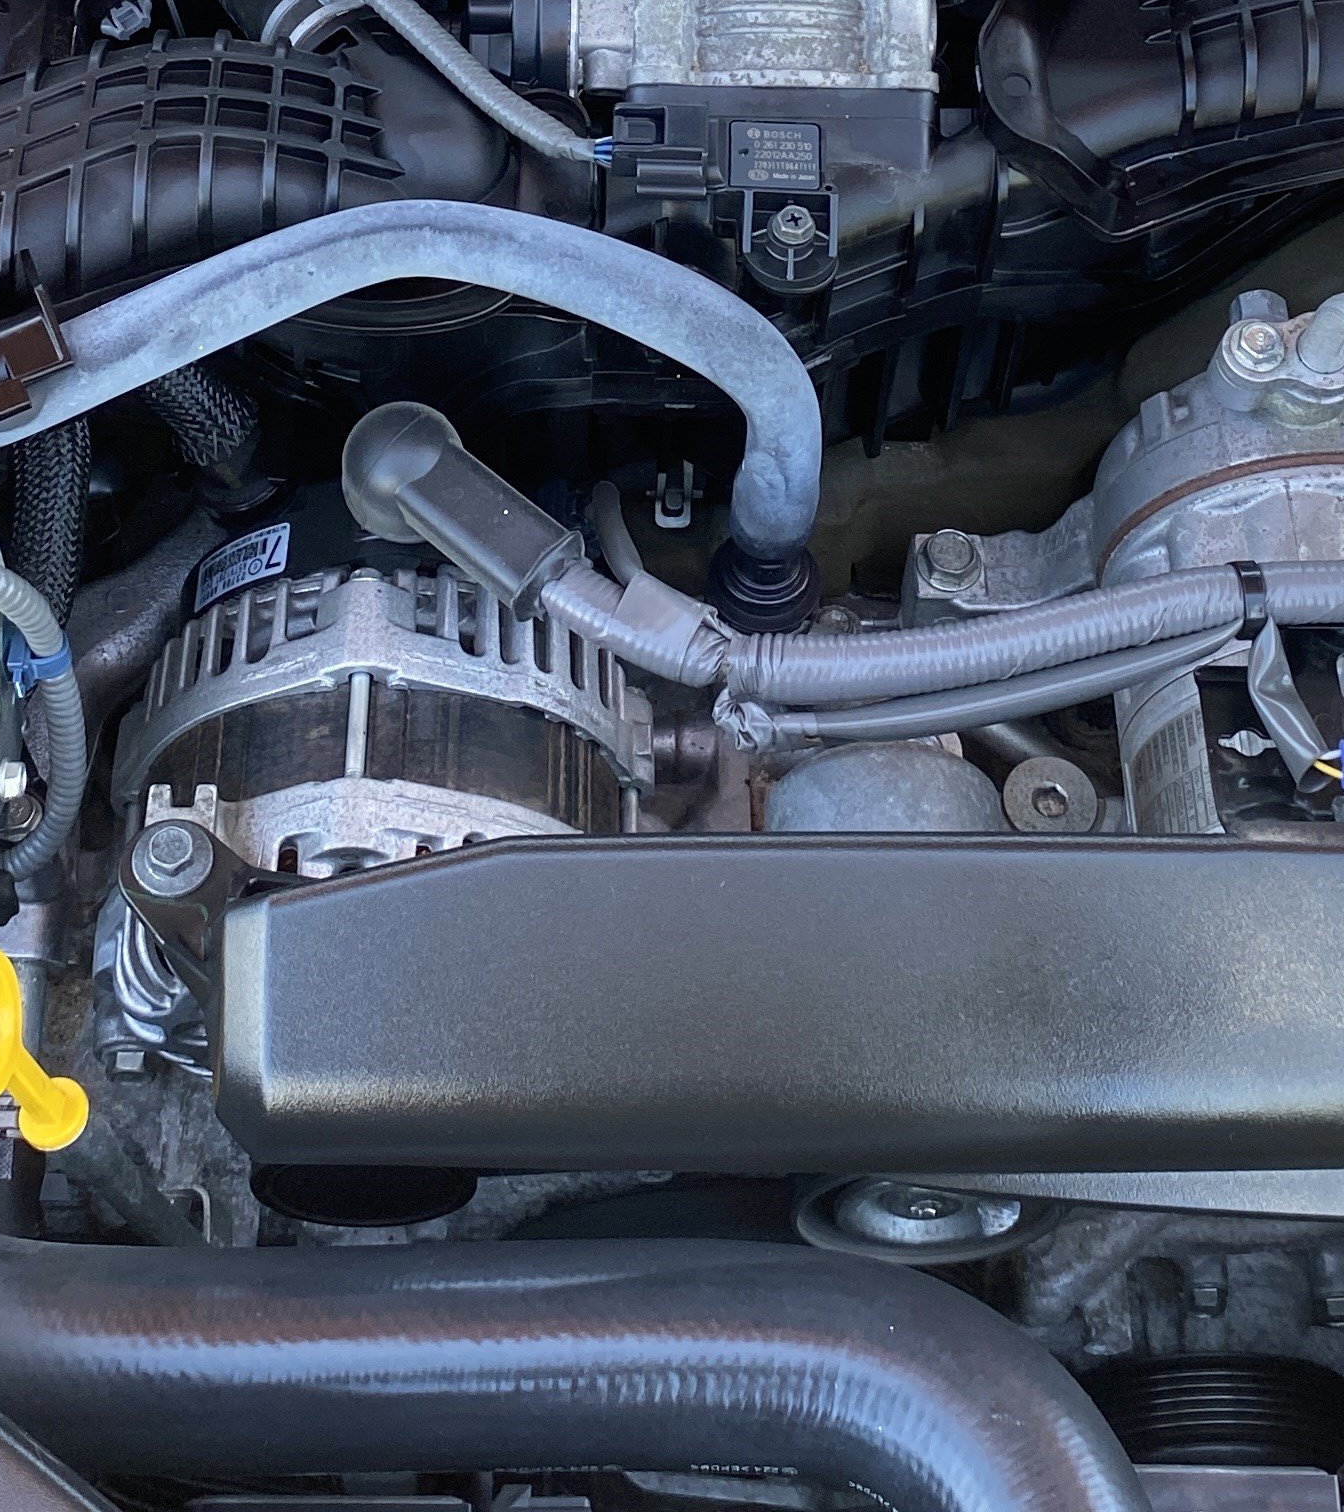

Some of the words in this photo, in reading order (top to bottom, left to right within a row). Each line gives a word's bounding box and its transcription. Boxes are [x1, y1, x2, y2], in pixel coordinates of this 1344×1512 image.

[763, 130, 802, 140] BOSCH
[754, 140, 760, 149] 0
[763, 140, 777, 150] 261
[779, 141, 795, 150] 230
[797, 141, 812, 151] 510
